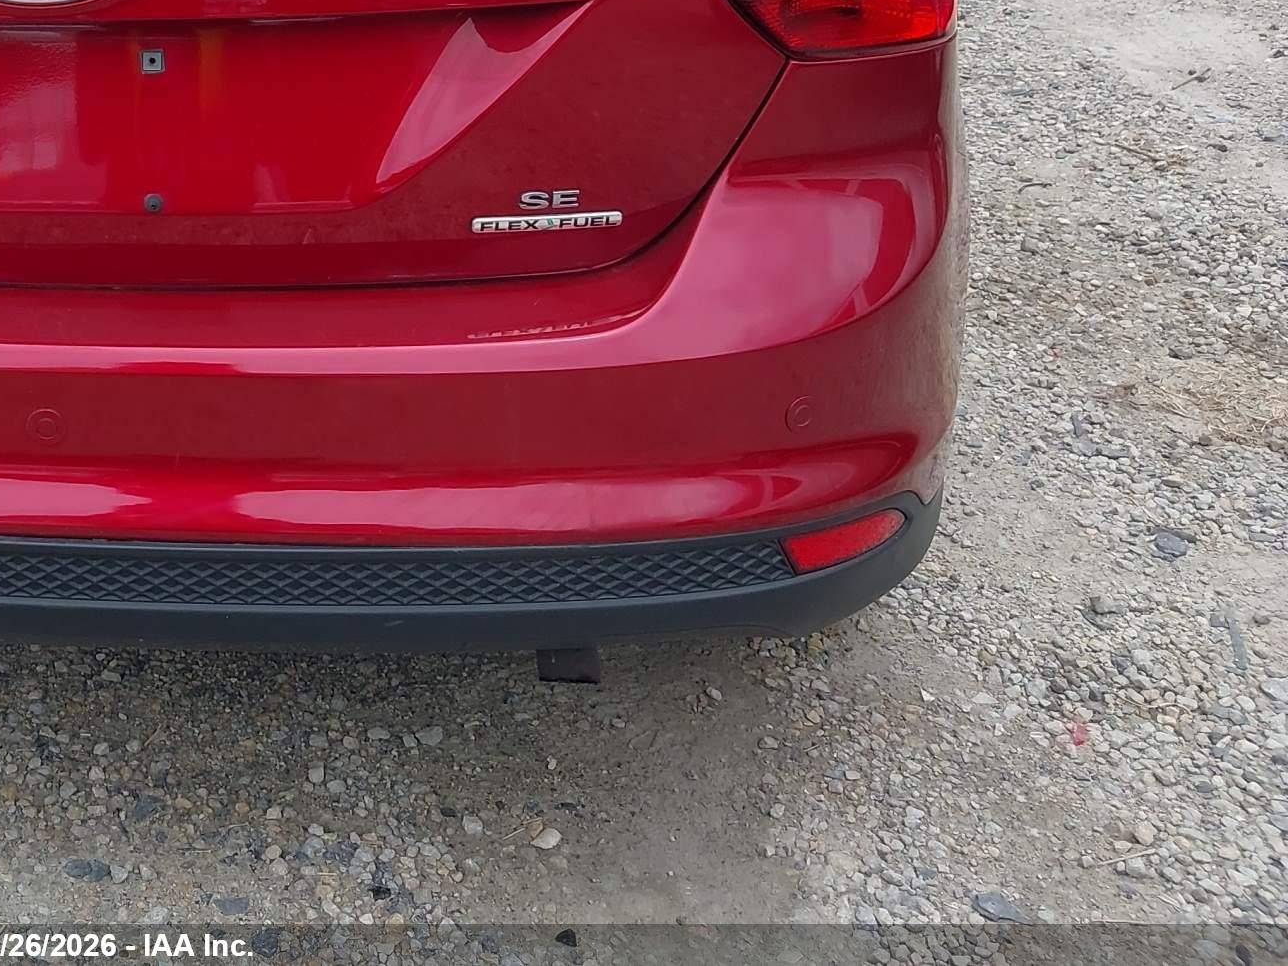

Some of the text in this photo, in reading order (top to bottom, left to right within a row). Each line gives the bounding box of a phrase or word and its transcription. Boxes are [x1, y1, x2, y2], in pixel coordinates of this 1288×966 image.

[519, 190, 580, 210] SE
[479, 215, 618, 232] FLEX FUEL
